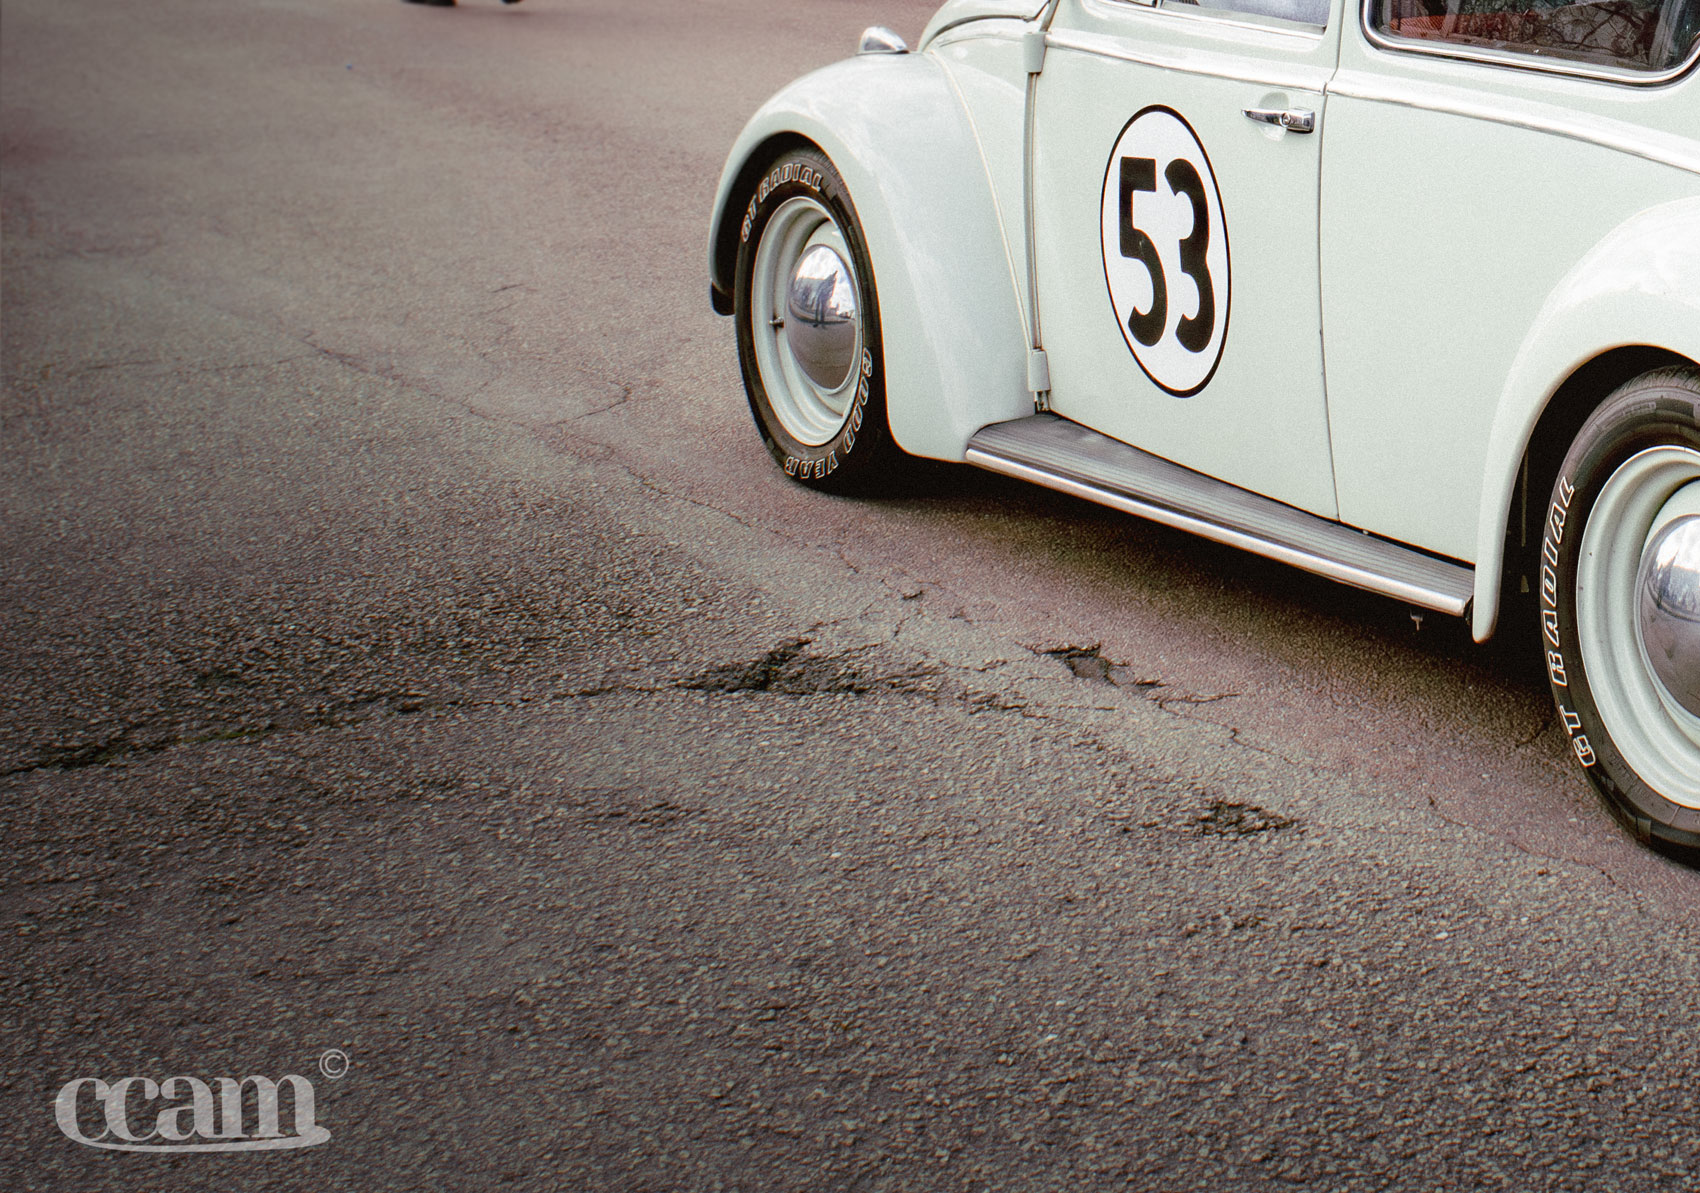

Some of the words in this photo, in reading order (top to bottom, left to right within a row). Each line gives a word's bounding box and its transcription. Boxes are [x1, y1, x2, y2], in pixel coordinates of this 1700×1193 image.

[758, 163, 823, 204] RADIAL
[1118, 155, 1216, 354] 53
[842, 347, 873, 455] GOOD
[784, 450, 840, 480] YEAR
[1541, 475, 1575, 687] RADIAL
[1558, 704, 1596, 768] GT
